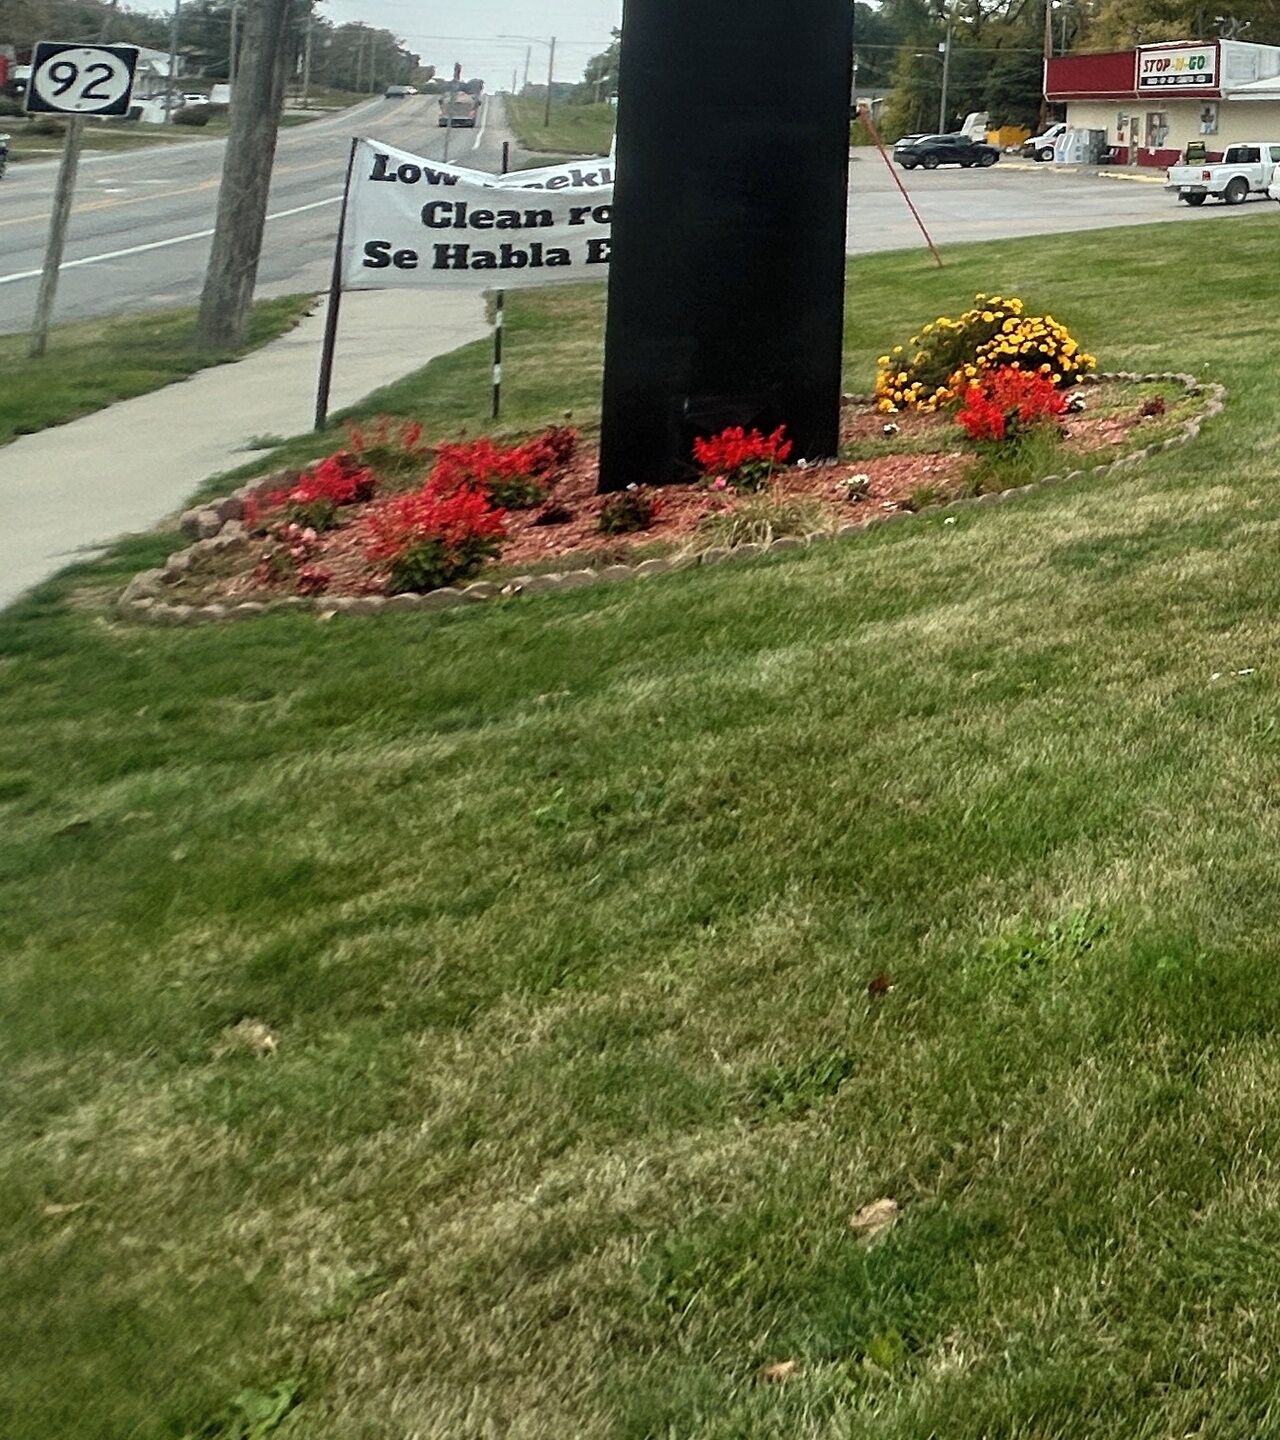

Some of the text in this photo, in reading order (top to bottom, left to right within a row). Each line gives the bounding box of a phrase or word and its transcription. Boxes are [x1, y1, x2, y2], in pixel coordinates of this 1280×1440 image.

[48, 61, 115, 100] 92
[369, 153, 460, 186] Low
[421, 200, 554, 229] Clean
[363, 241, 418, 269] Se
[432, 242, 571, 269] Habla
